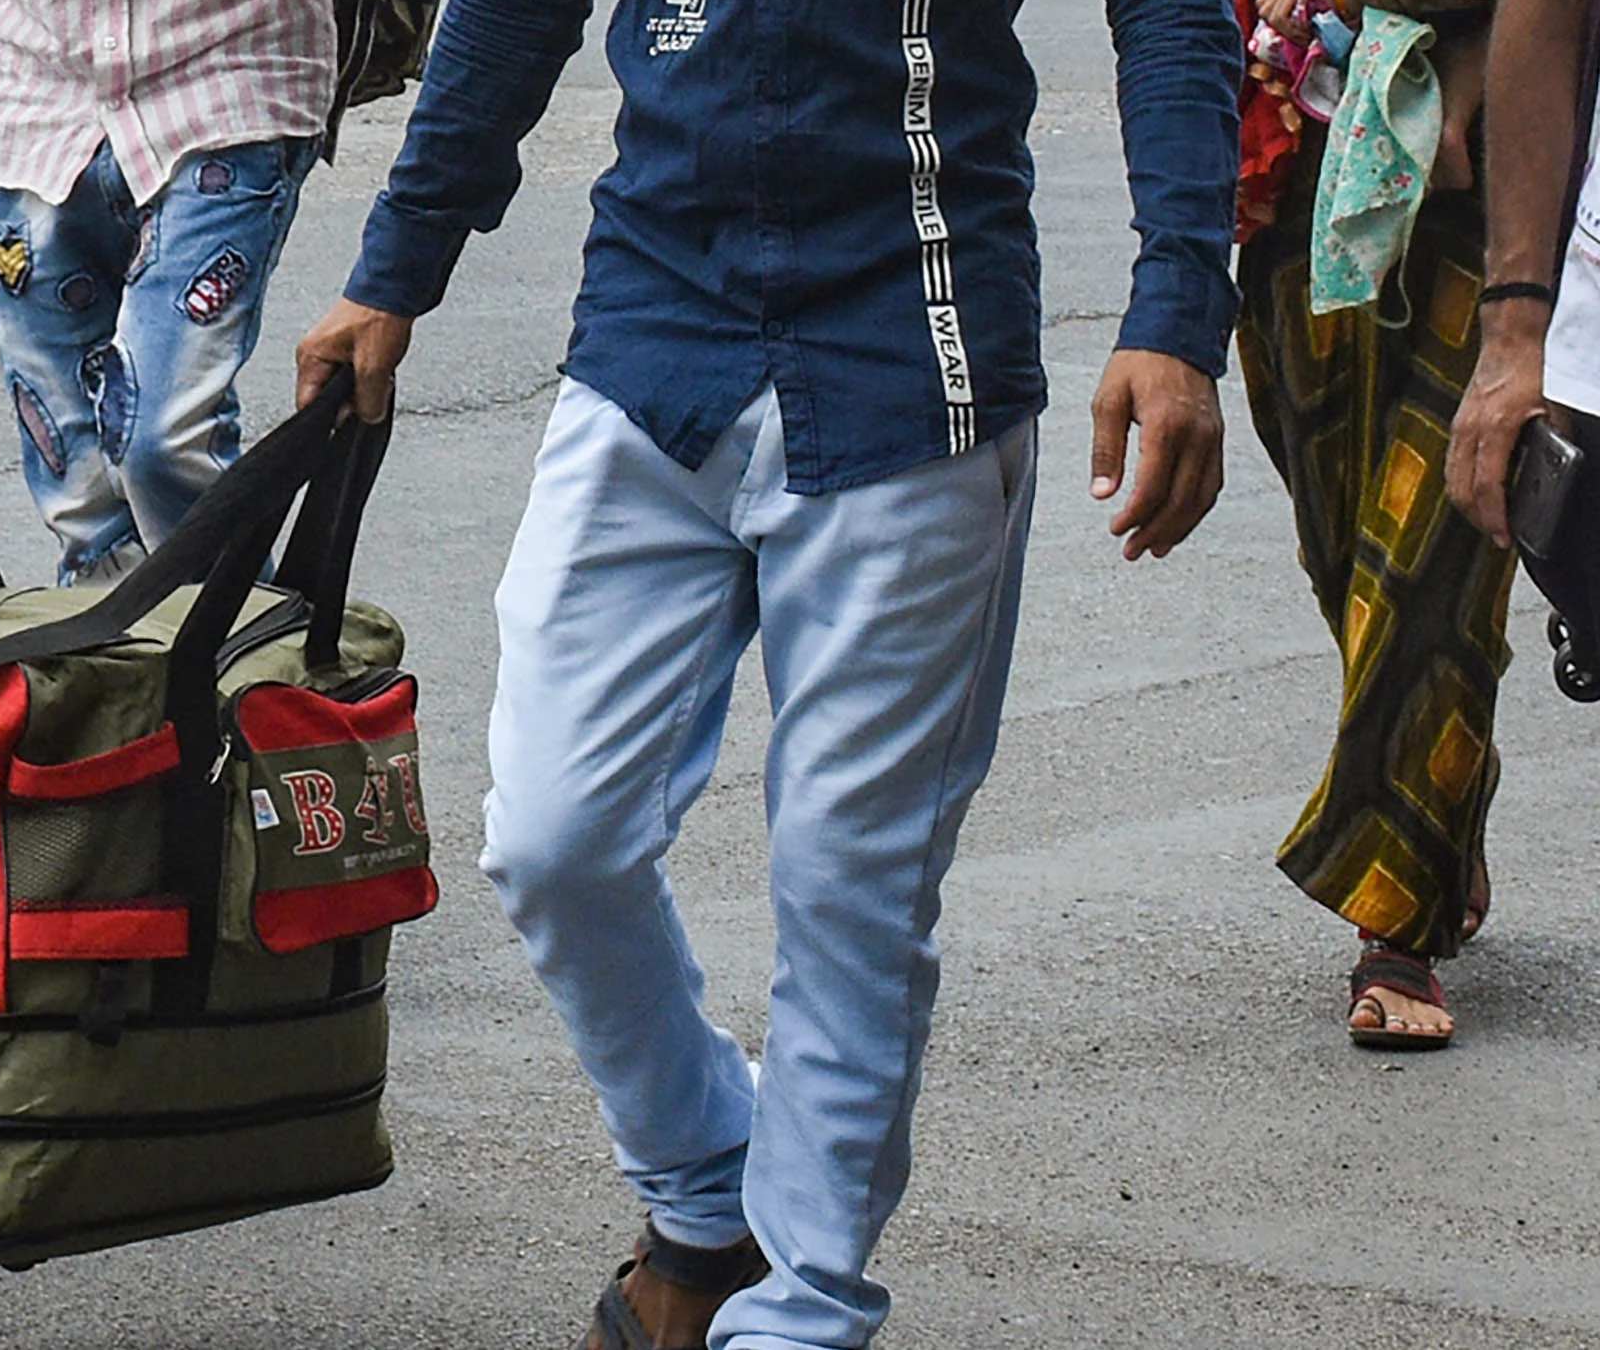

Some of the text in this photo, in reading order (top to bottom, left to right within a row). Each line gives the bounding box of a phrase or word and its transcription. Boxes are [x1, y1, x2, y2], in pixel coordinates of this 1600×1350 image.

[907, 41, 967, 393] DENIM STILE WEAR
